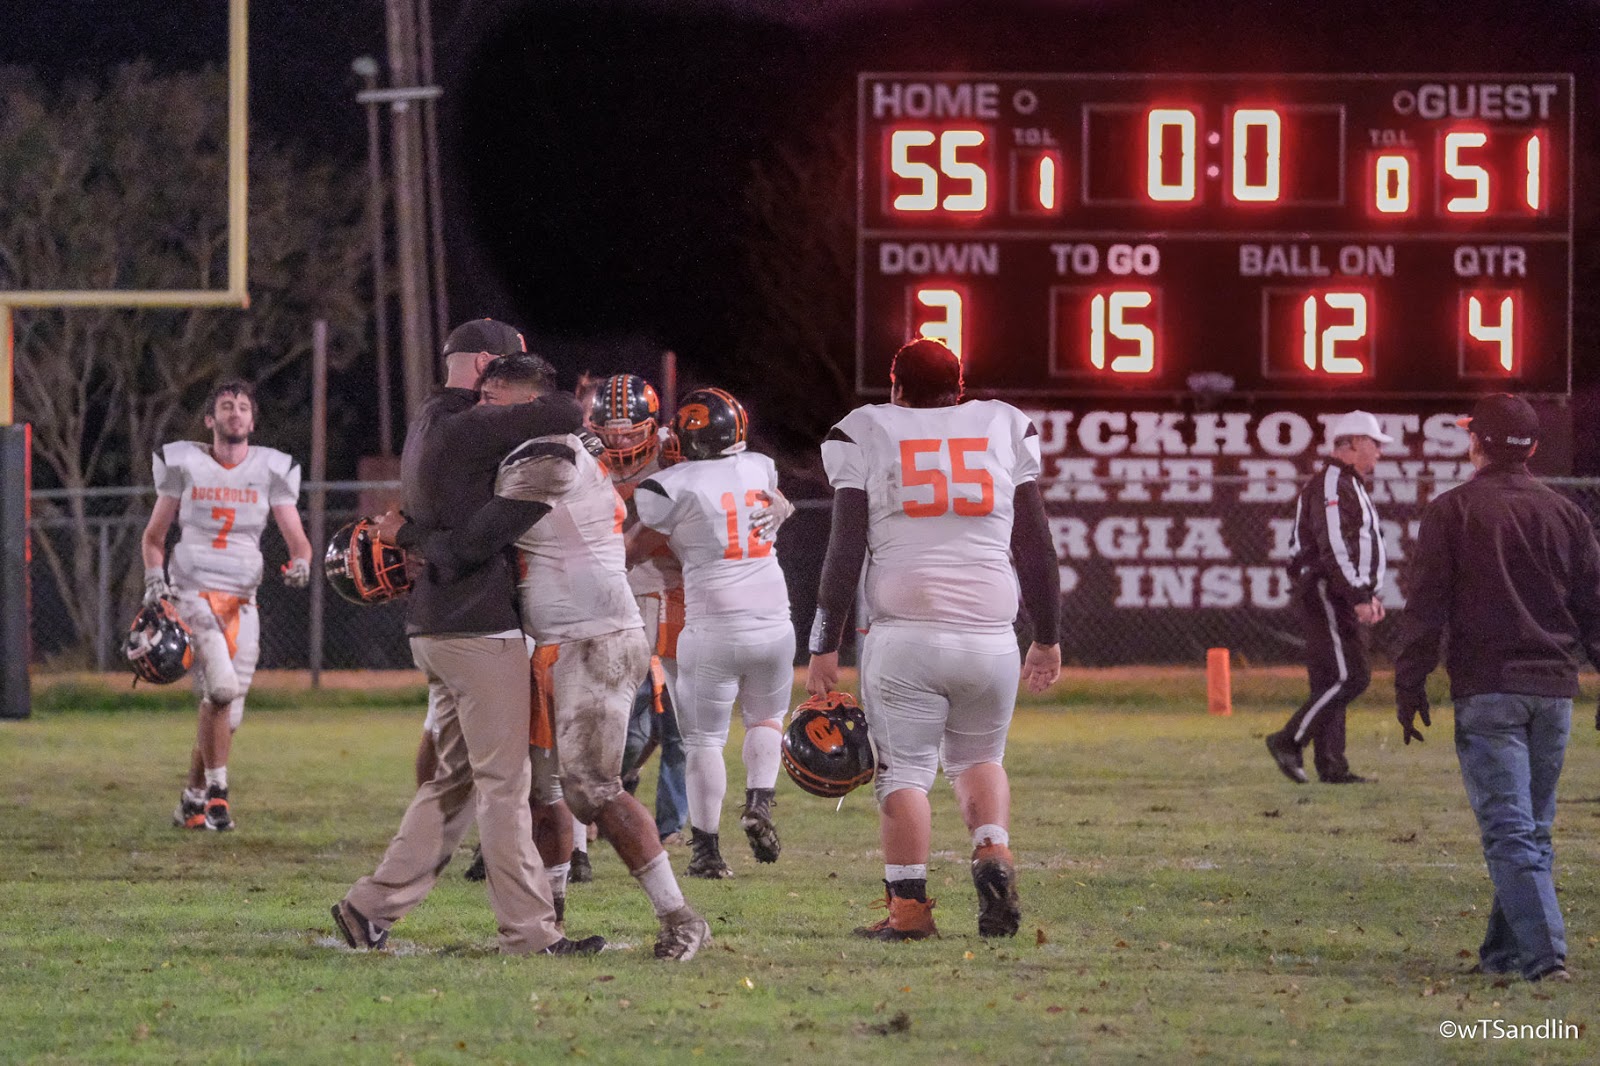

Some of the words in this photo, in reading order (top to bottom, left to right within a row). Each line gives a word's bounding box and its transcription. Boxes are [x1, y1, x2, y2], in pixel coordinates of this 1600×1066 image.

[873, 84, 1000, 118] HOME
[1417, 85, 1557, 119] GUEST
[892, 130, 987, 211] 55
[1039, 156, 1055, 209] 1
[1376, 156, 1409, 213] 0
[1445, 133, 1540, 213] 51
[879, 244, 998, 275] DOWN
[1050, 244, 1099, 275] TO
[1107, 244, 1160, 275] GO
[1239, 246, 1330, 276] BALL
[1339, 246, 1395, 276] ON
[1454, 246, 1527, 276] QTR
[1091, 292, 1154, 372] 15
[1304, 293, 1367, 373] 12
[1469, 296, 1513, 371] 4
[1022, 410, 1472, 457] UCKHOTS
[900, 438, 994, 517] 55
[1041, 458, 1213, 502] ATE
[1239, 459, 1476, 503] BNK
[211, 507, 236, 549] 7
[721, 489, 773, 561] 12
[1048, 516, 1232, 560] RGIA
